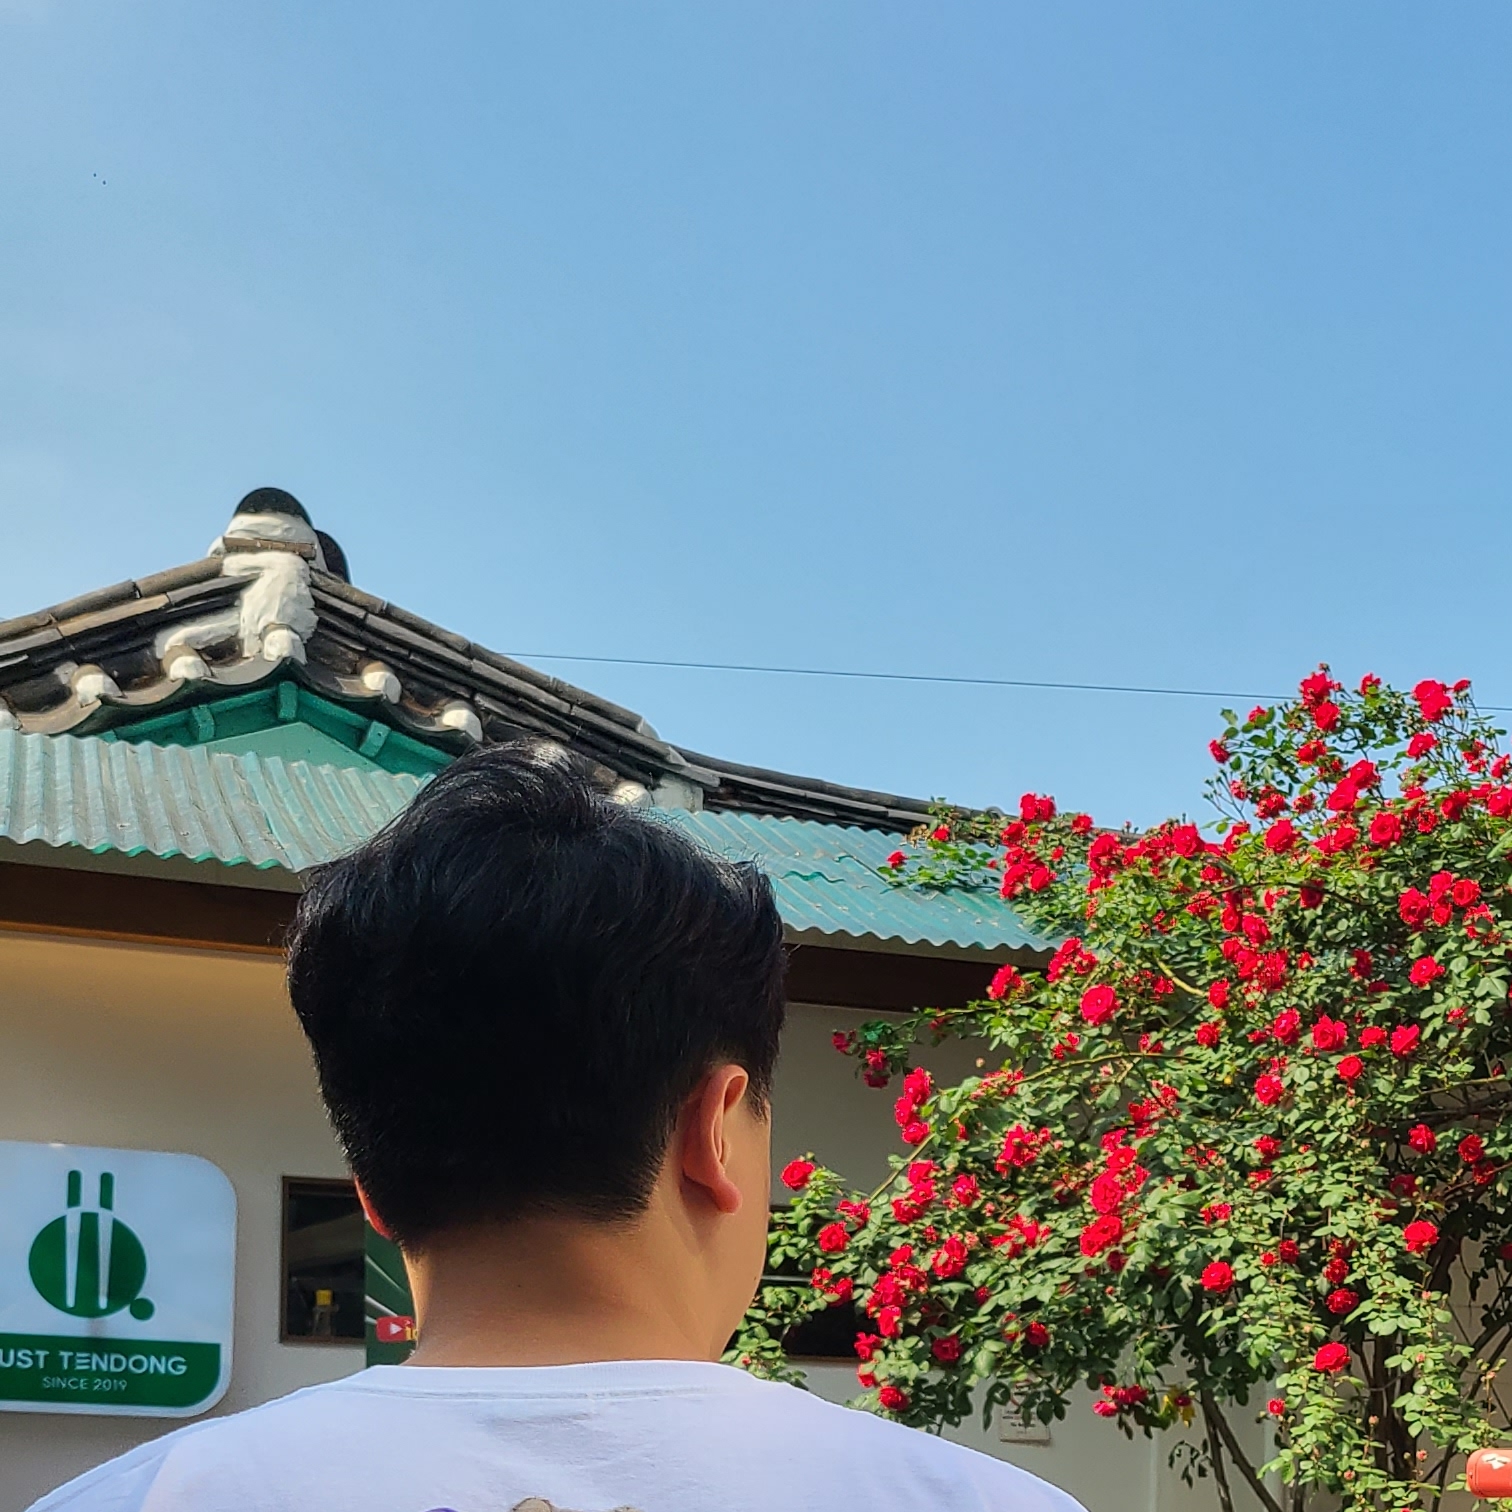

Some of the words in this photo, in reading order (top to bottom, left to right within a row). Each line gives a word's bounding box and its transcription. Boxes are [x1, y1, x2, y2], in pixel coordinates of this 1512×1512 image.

[59, 1350, 188, 1376] TENDONG
[42, 1376, 88, 1390] SINCE
[92, 1377, 128, 1392] 2019
